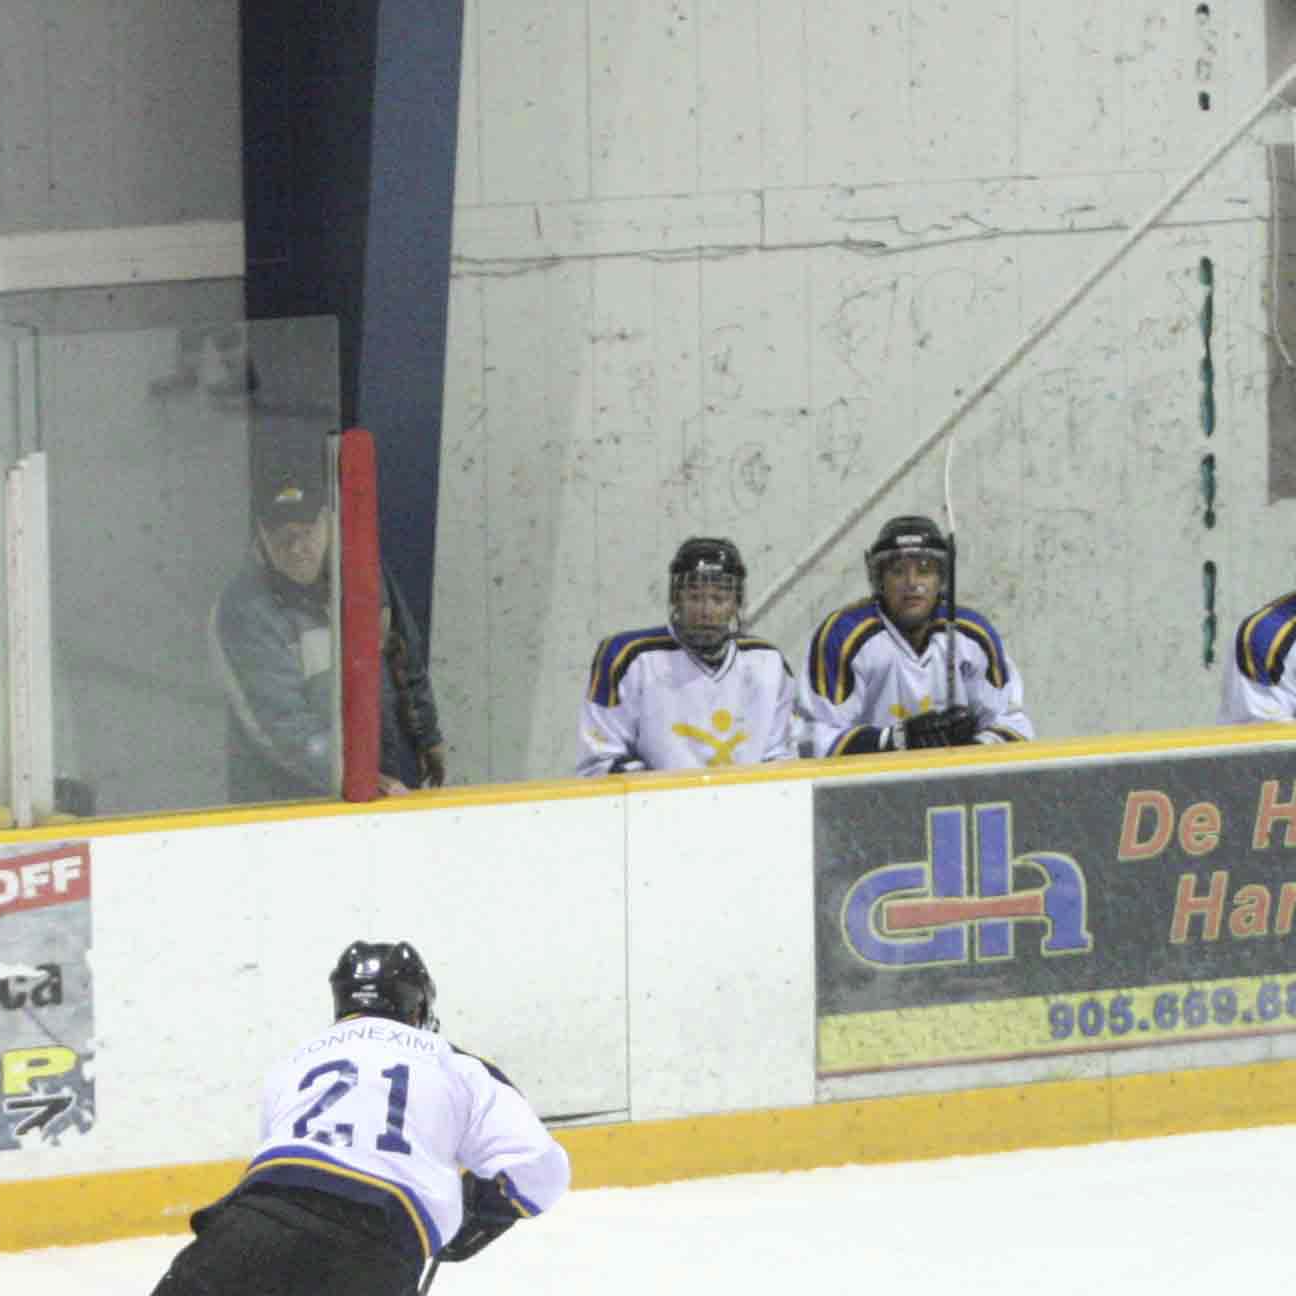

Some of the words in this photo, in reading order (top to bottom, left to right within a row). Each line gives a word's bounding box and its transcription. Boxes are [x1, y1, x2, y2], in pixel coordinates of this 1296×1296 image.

[1116, 789, 1222, 862] De
[295, 1025, 438, 1060] ONNEXIM
[292, 1058, 413, 1156] 21
